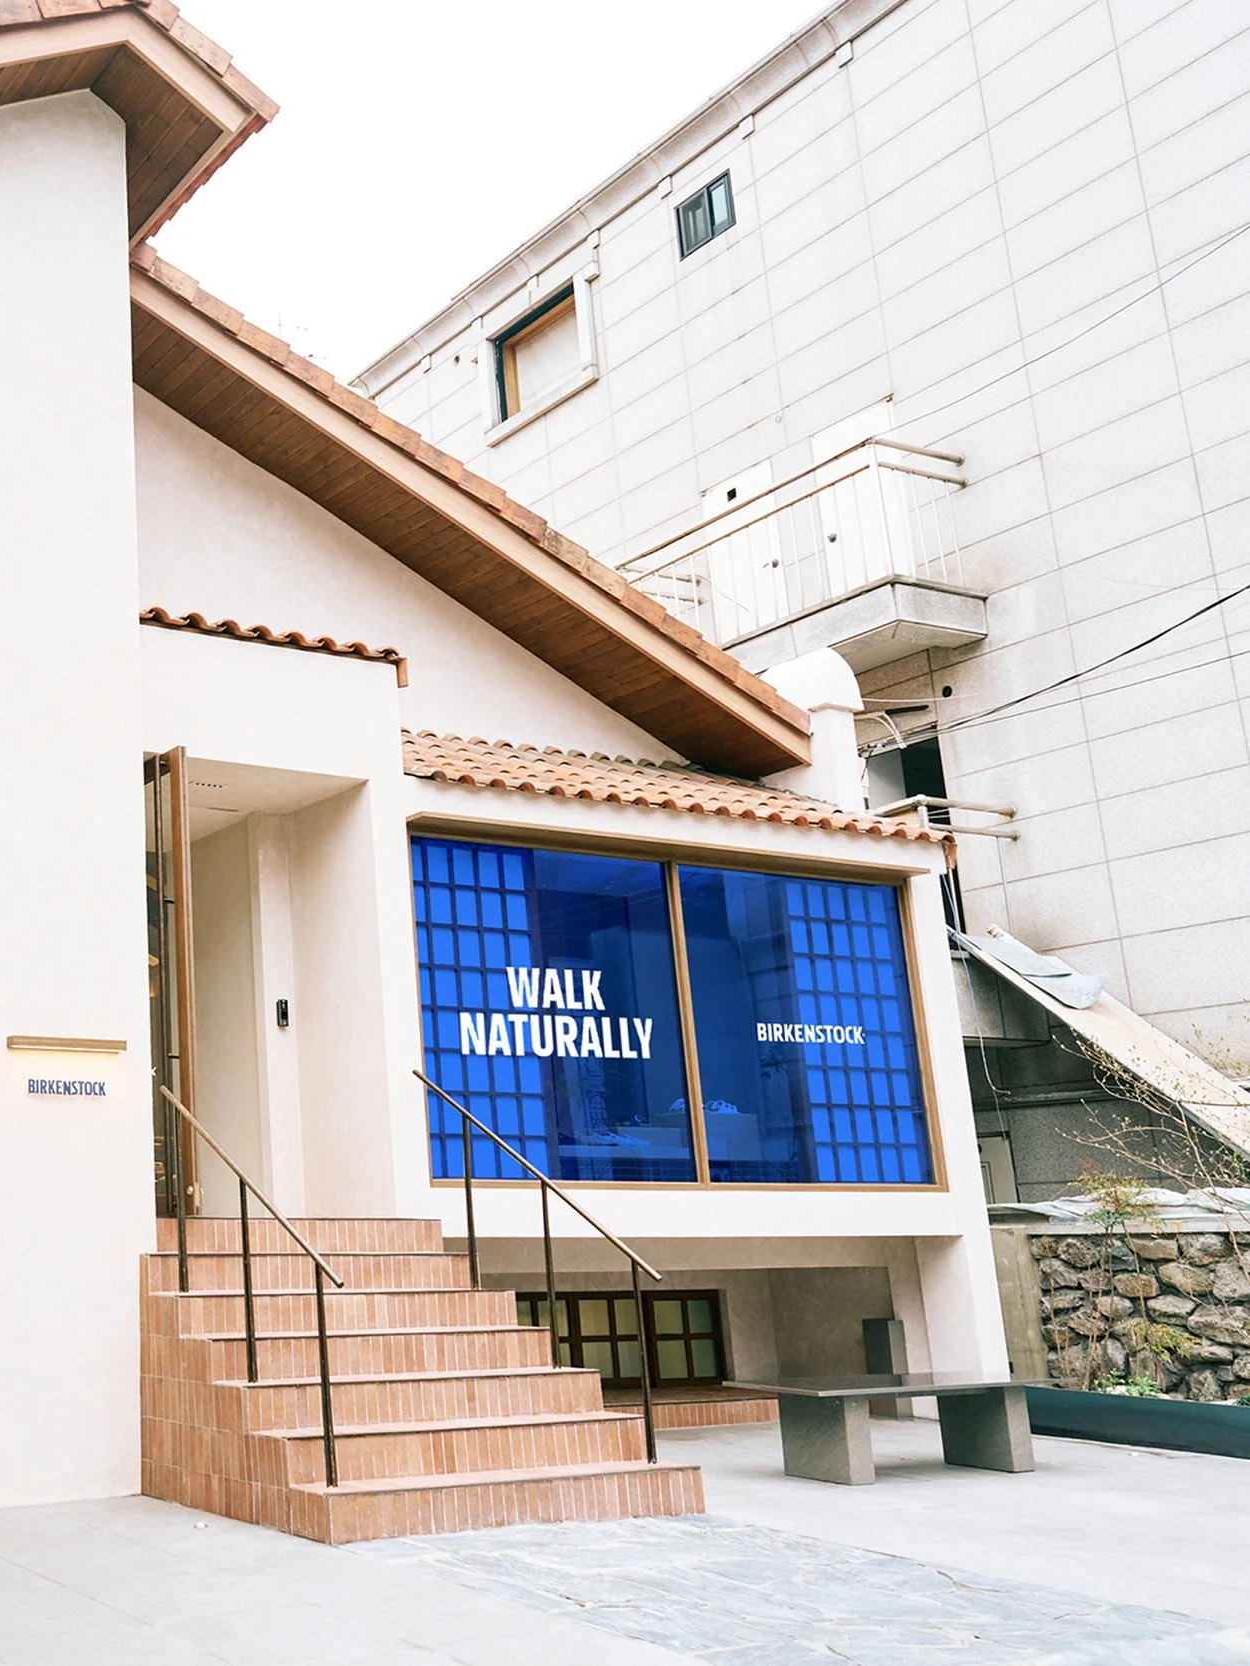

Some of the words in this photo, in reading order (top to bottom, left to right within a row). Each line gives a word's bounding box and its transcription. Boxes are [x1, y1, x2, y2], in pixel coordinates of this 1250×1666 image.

[506, 966, 605, 1010] WALK
[459, 1012, 652, 1059] NATURALLY
[756, 1022, 865, 1044] BIRKENSTOCK
[28, 1079, 106, 1096] BIRKENSTOCK
